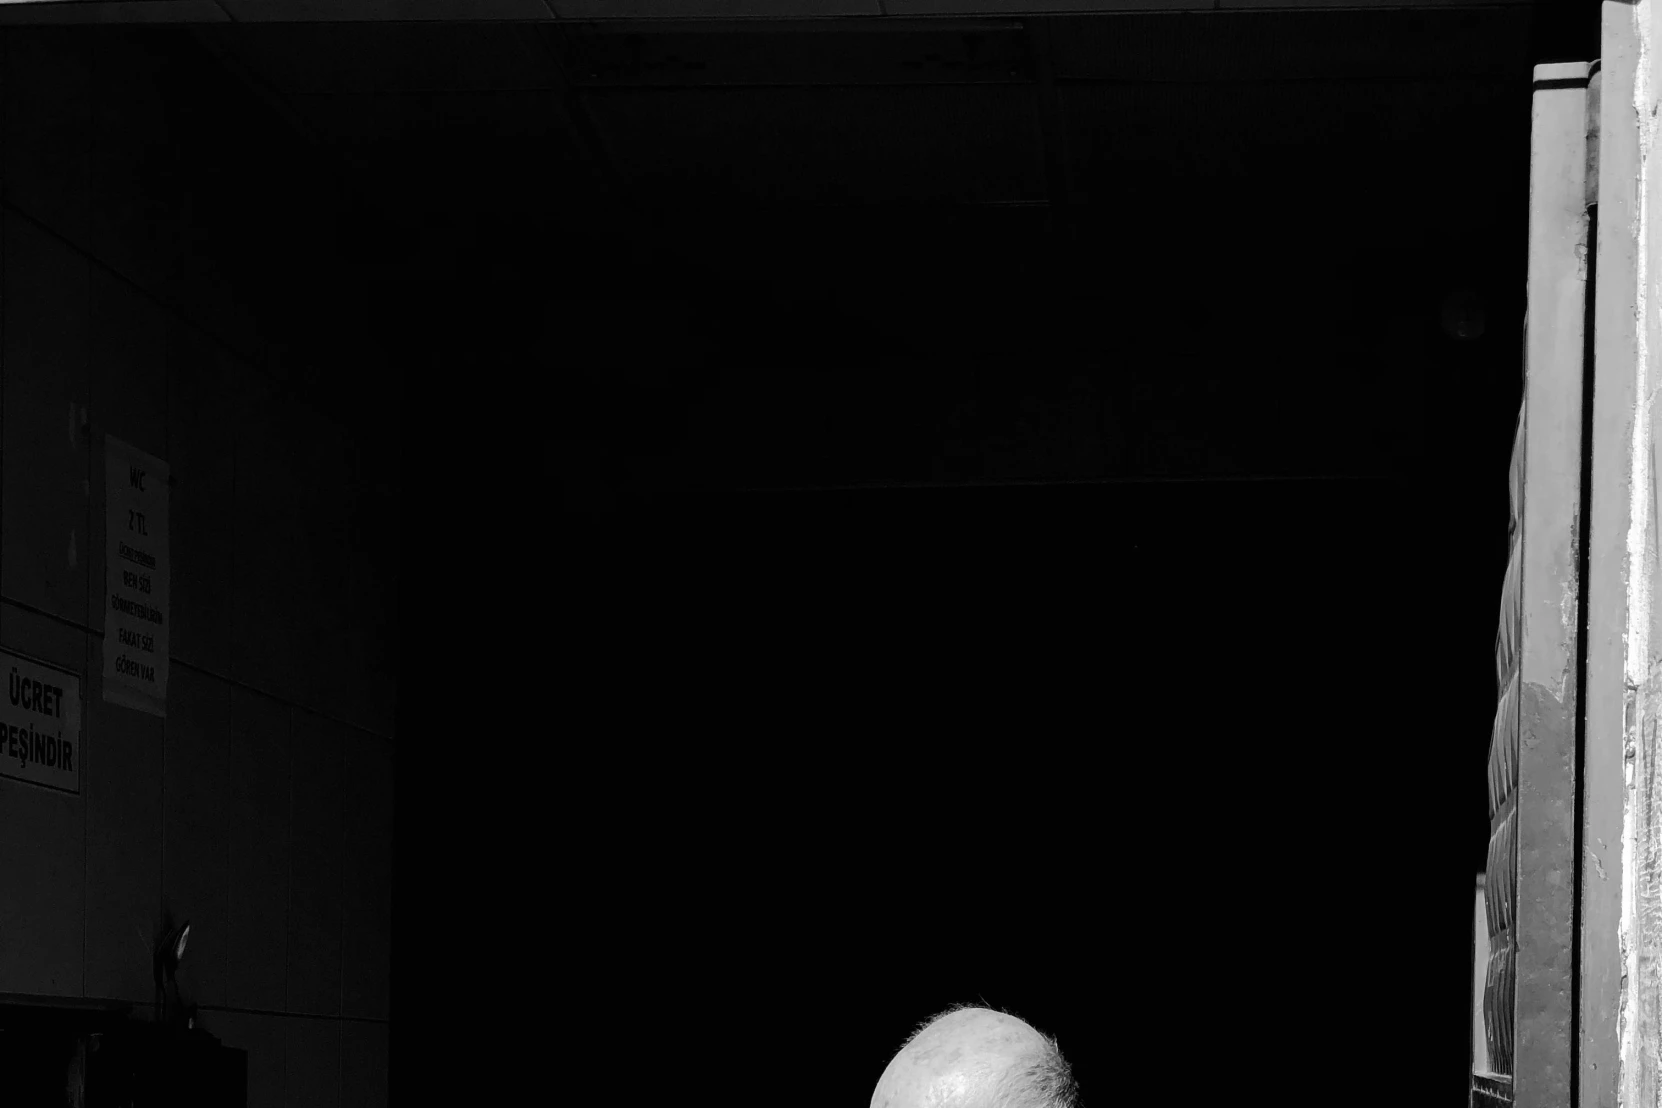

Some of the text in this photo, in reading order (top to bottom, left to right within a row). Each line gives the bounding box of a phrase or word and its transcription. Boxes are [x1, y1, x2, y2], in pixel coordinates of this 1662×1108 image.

[130, 466, 146, 492] WC
[129, 509, 148, 536] 2 TL
[123, 570, 138, 590] BEN
[119, 628, 141, 649] FAKAT
[115, 654, 155, 682] GÖREN VAR
[9, 666, 63, 718] ÜCRET
[0, 721, 73, 772] PEŞİNDİR
